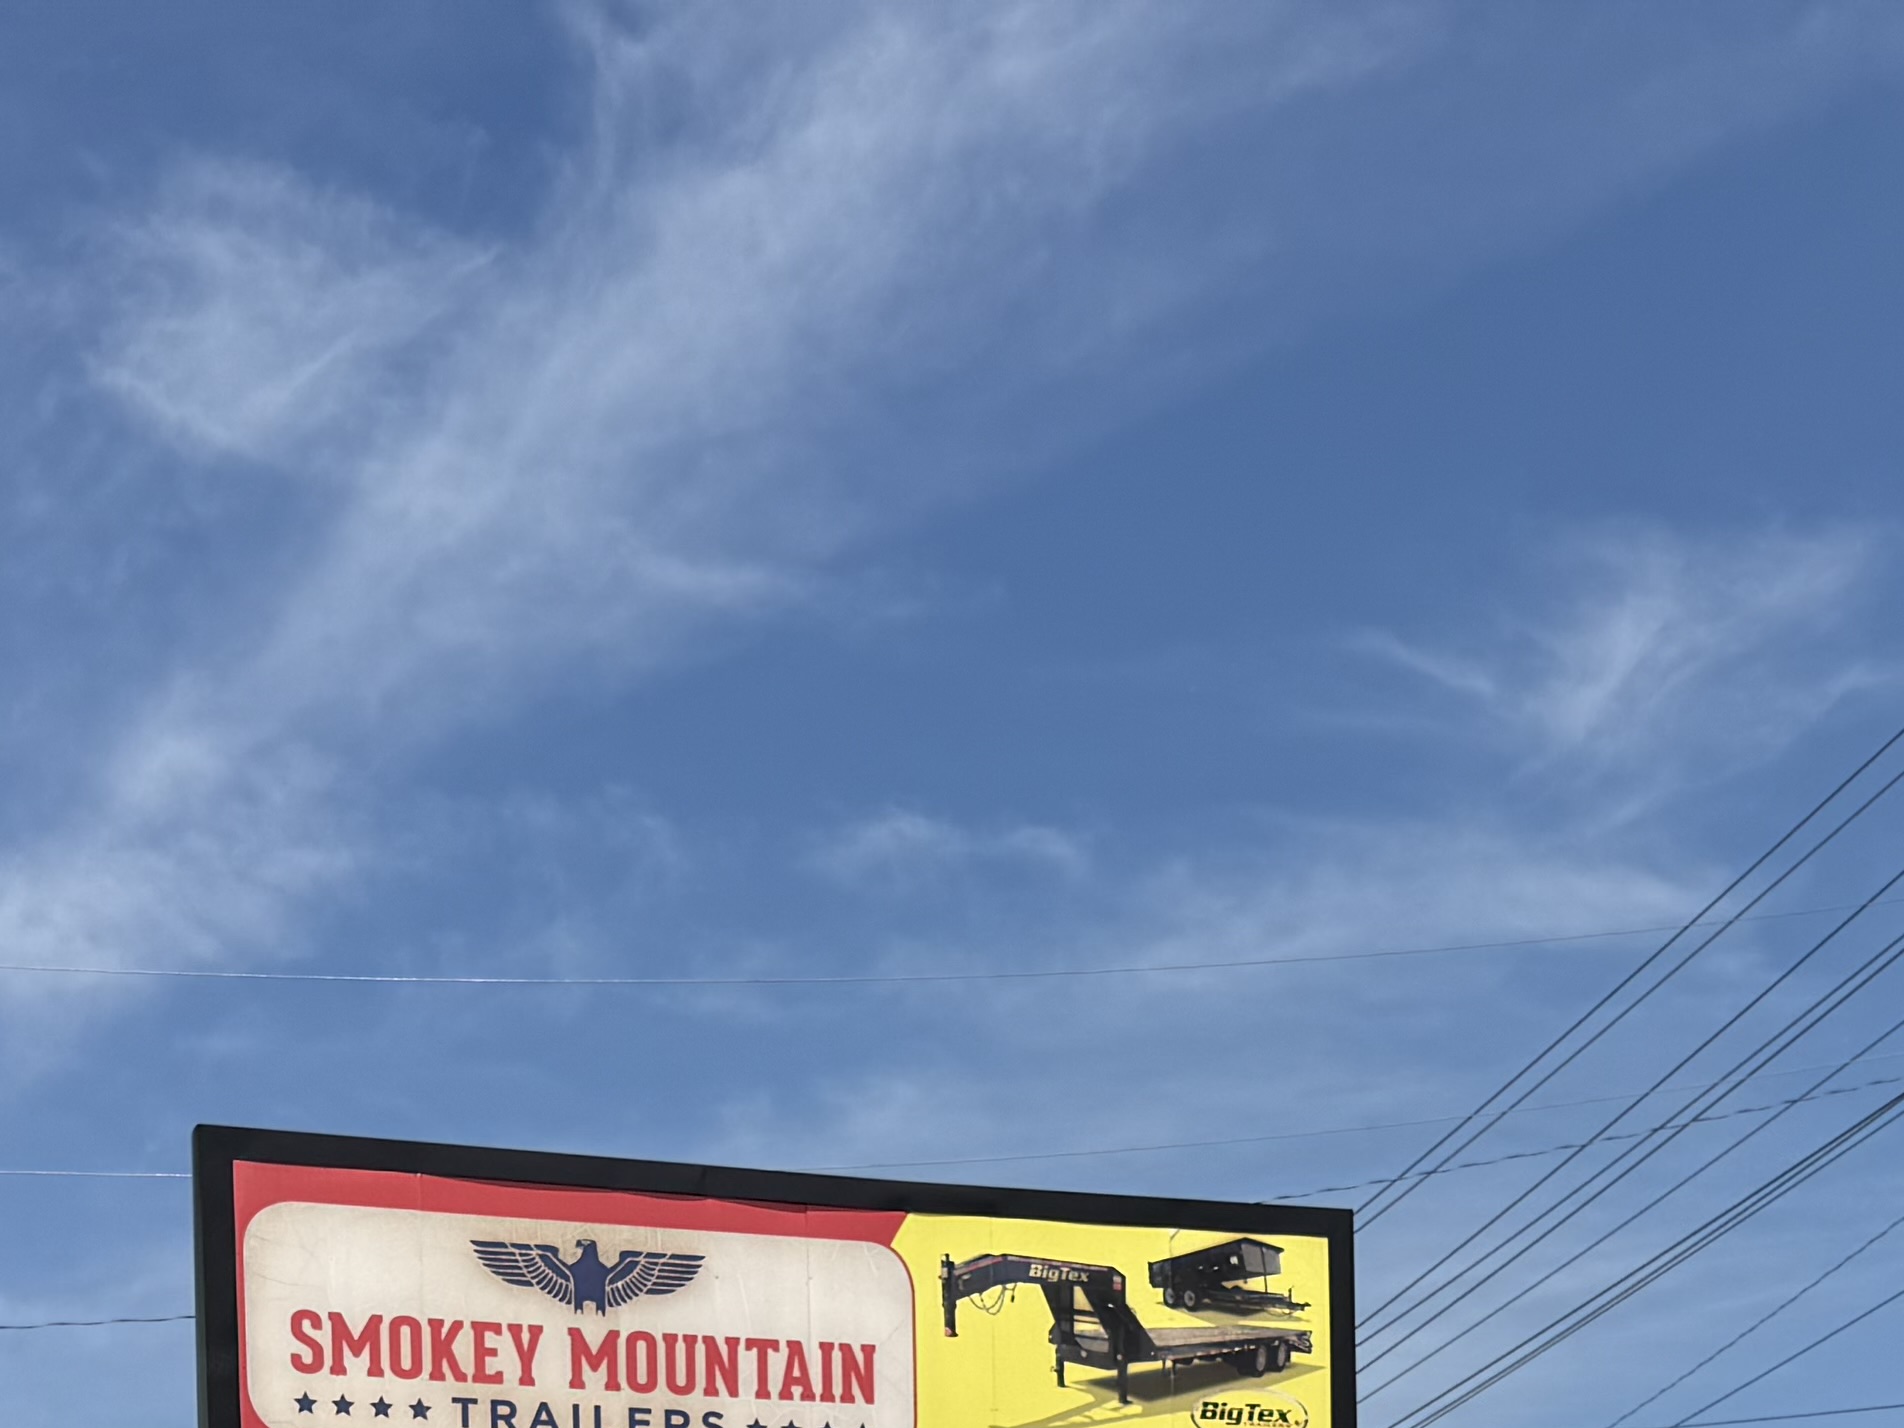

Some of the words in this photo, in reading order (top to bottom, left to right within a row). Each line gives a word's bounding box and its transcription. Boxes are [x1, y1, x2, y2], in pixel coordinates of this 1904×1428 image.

[1028, 1263, 1090, 1283] BigTex
[290, 1308, 544, 1387] SMOKEY
[567, 1327, 876, 1405] MOUNTAIN
[1199, 1401, 1292, 1426] BigTex
